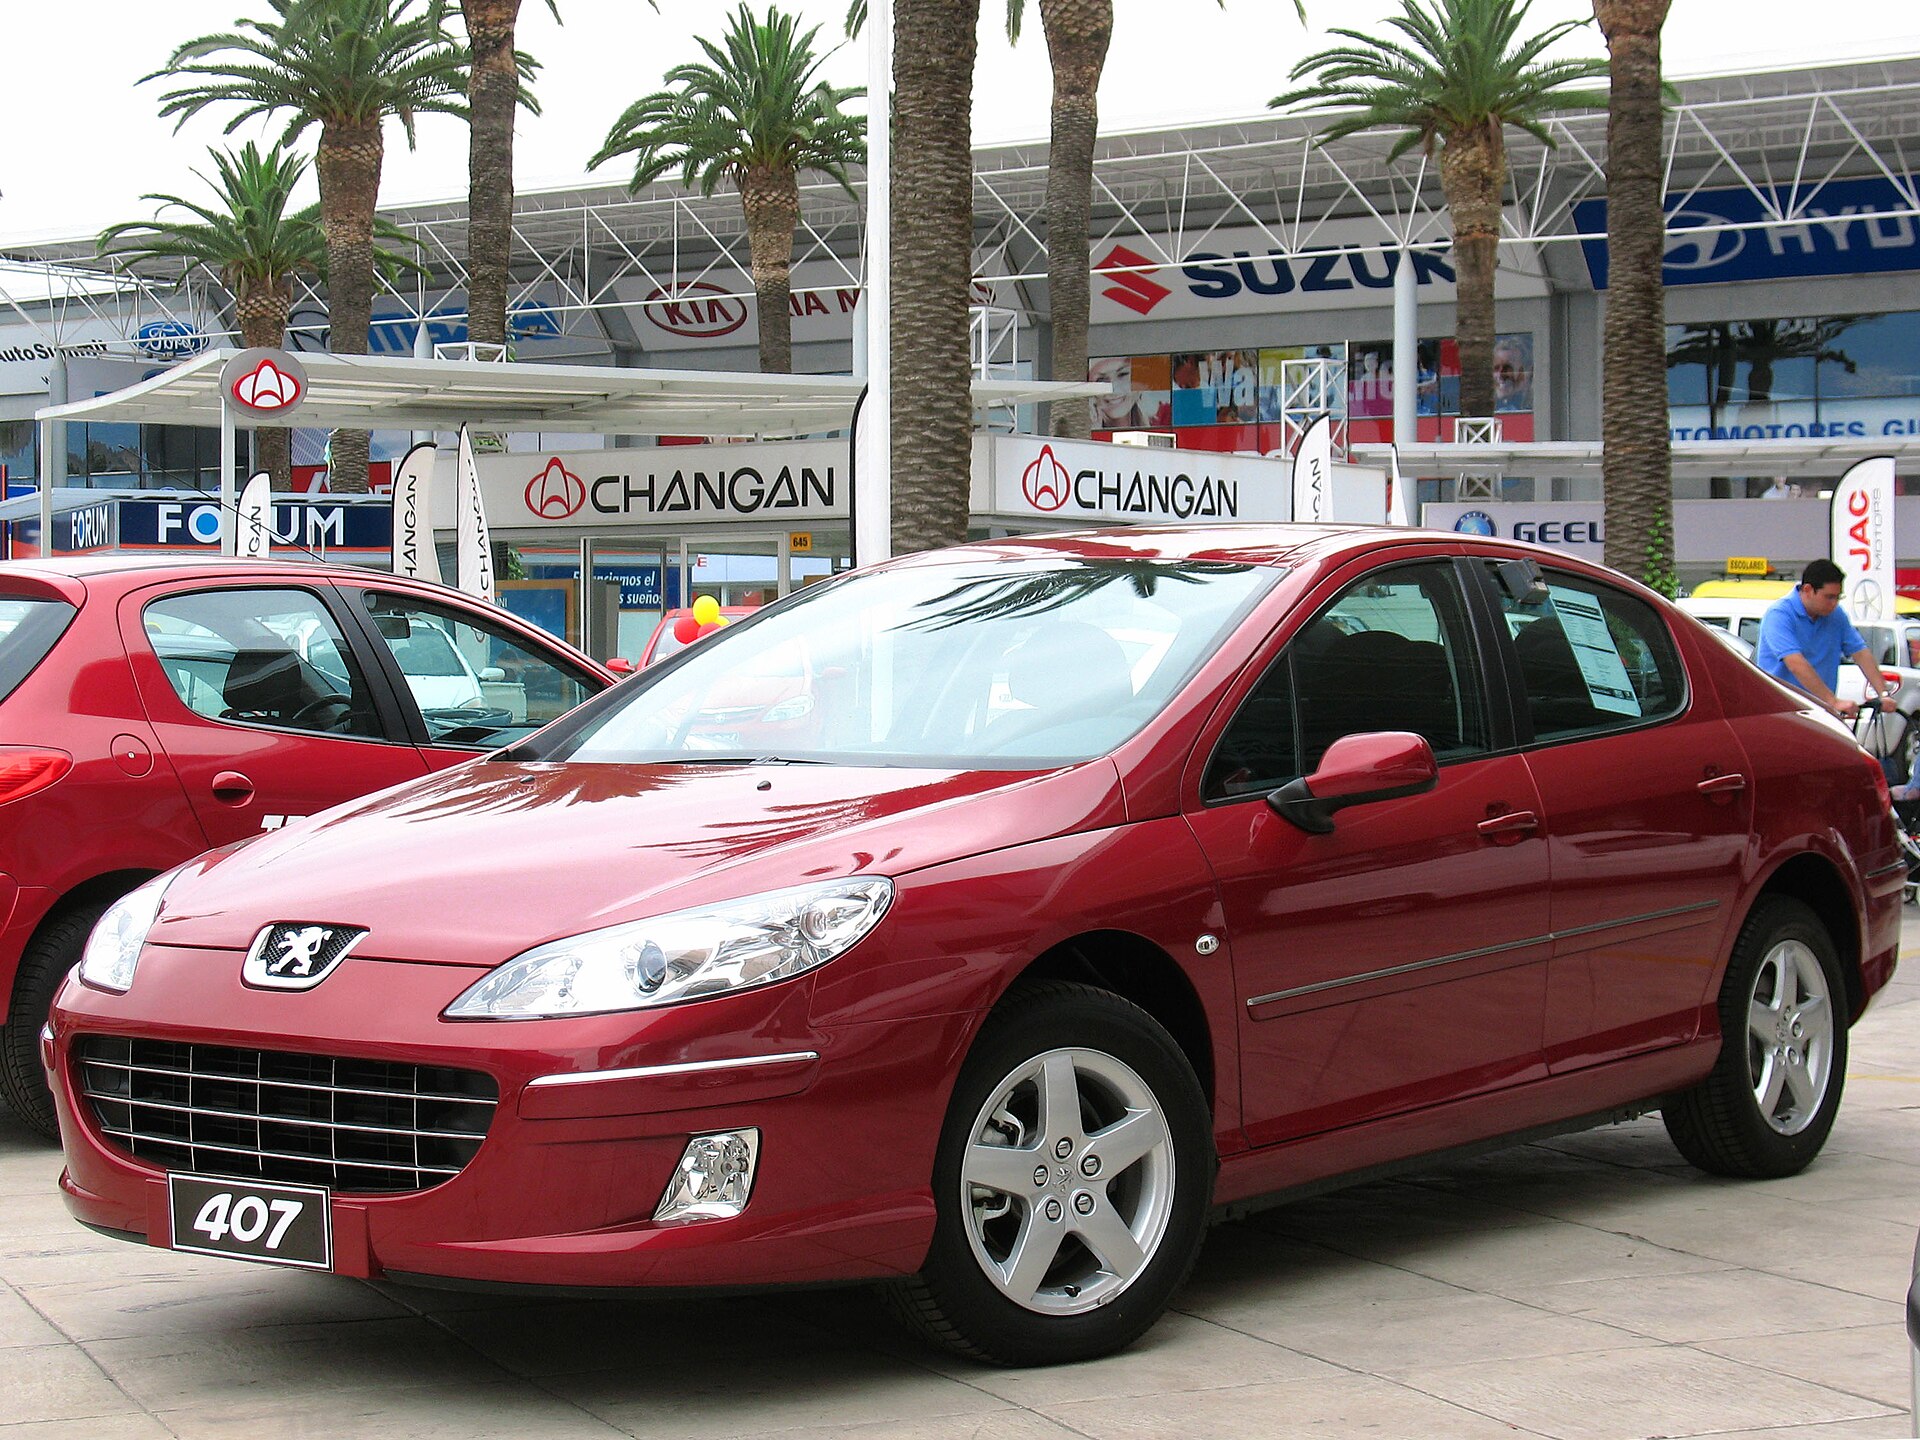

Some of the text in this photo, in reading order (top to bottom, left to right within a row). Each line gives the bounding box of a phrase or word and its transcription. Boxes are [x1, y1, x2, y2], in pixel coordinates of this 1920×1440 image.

[662, 298, 735, 326] KIA
[789, 291, 830, 316] IA
[1670, 421, 1866, 441] TOMOTORES
[590, 466, 834, 513] CHANGAN
[1074, 470, 1237, 519] CHANGAN
[71, 504, 109, 549] FORUM
[158, 503, 344, 546] FOUM
[793, 536, 808, 547] 645
[1849, 489, 1871, 571] JAC
[1873, 488, 1882, 571] MOTORS
[644, 571, 655, 586] el
[193, 1192, 303, 1249] 407
